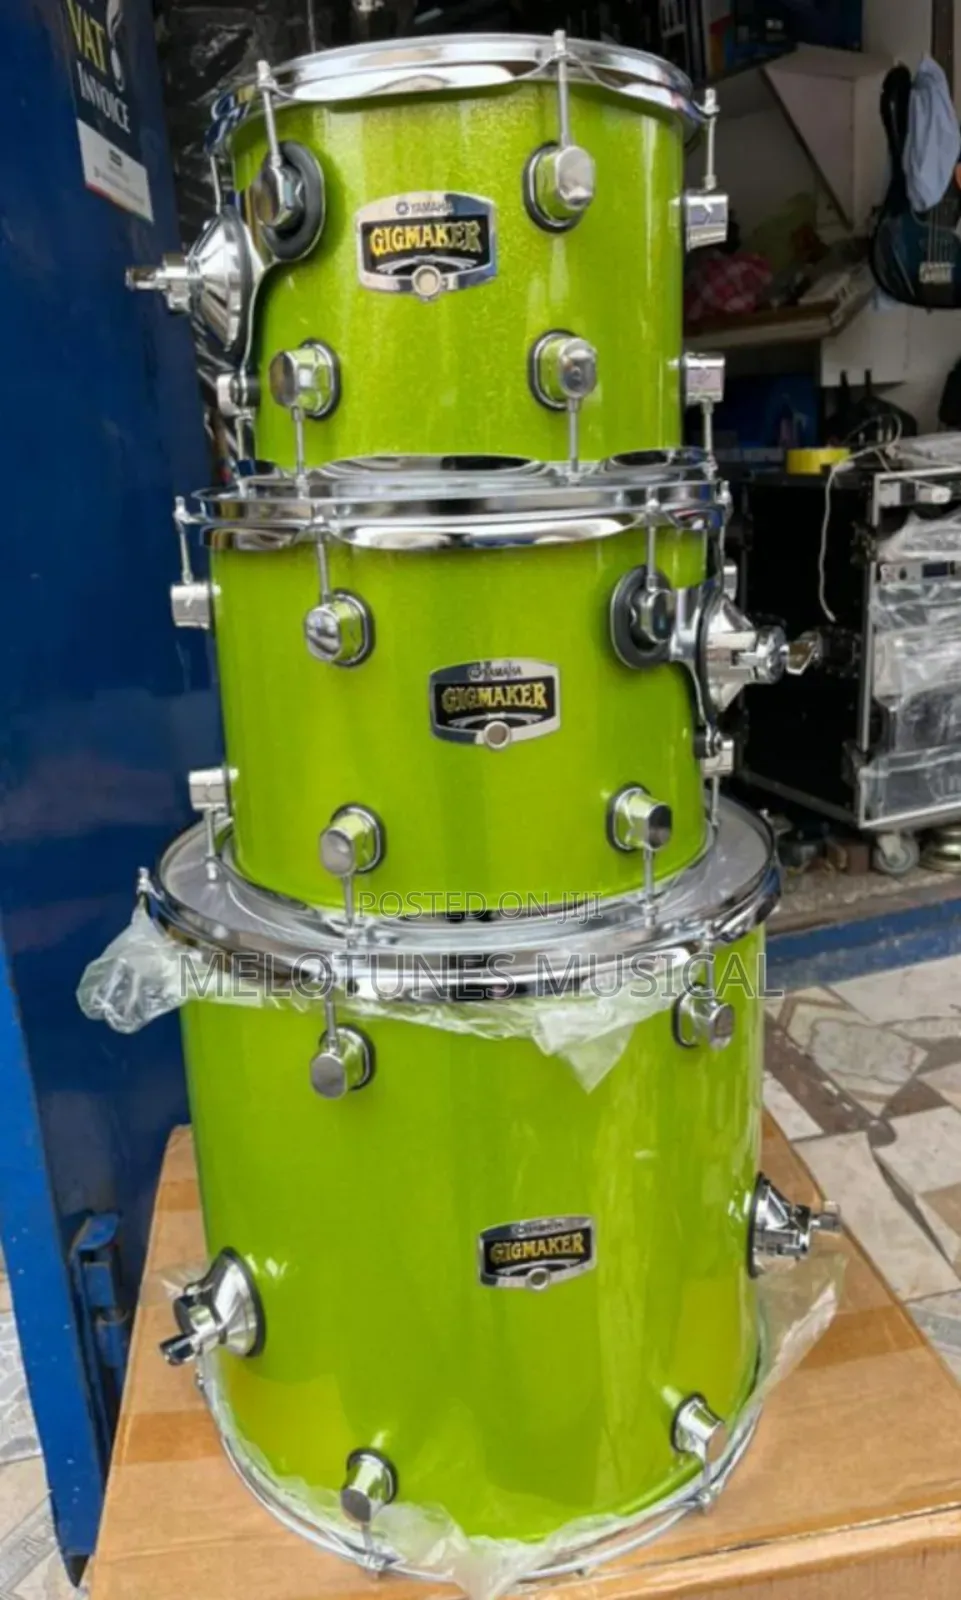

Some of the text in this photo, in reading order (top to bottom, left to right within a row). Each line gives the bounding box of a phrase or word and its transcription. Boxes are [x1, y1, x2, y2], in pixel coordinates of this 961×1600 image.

[67, 0, 107, 74] VAT
[76, 60, 131, 134] INVOICE
[370, 220, 482, 257] GIGMAKER
[442, 682, 547, 713] GIGMAKER
[490, 1232, 584, 1264] GIGMAKER
